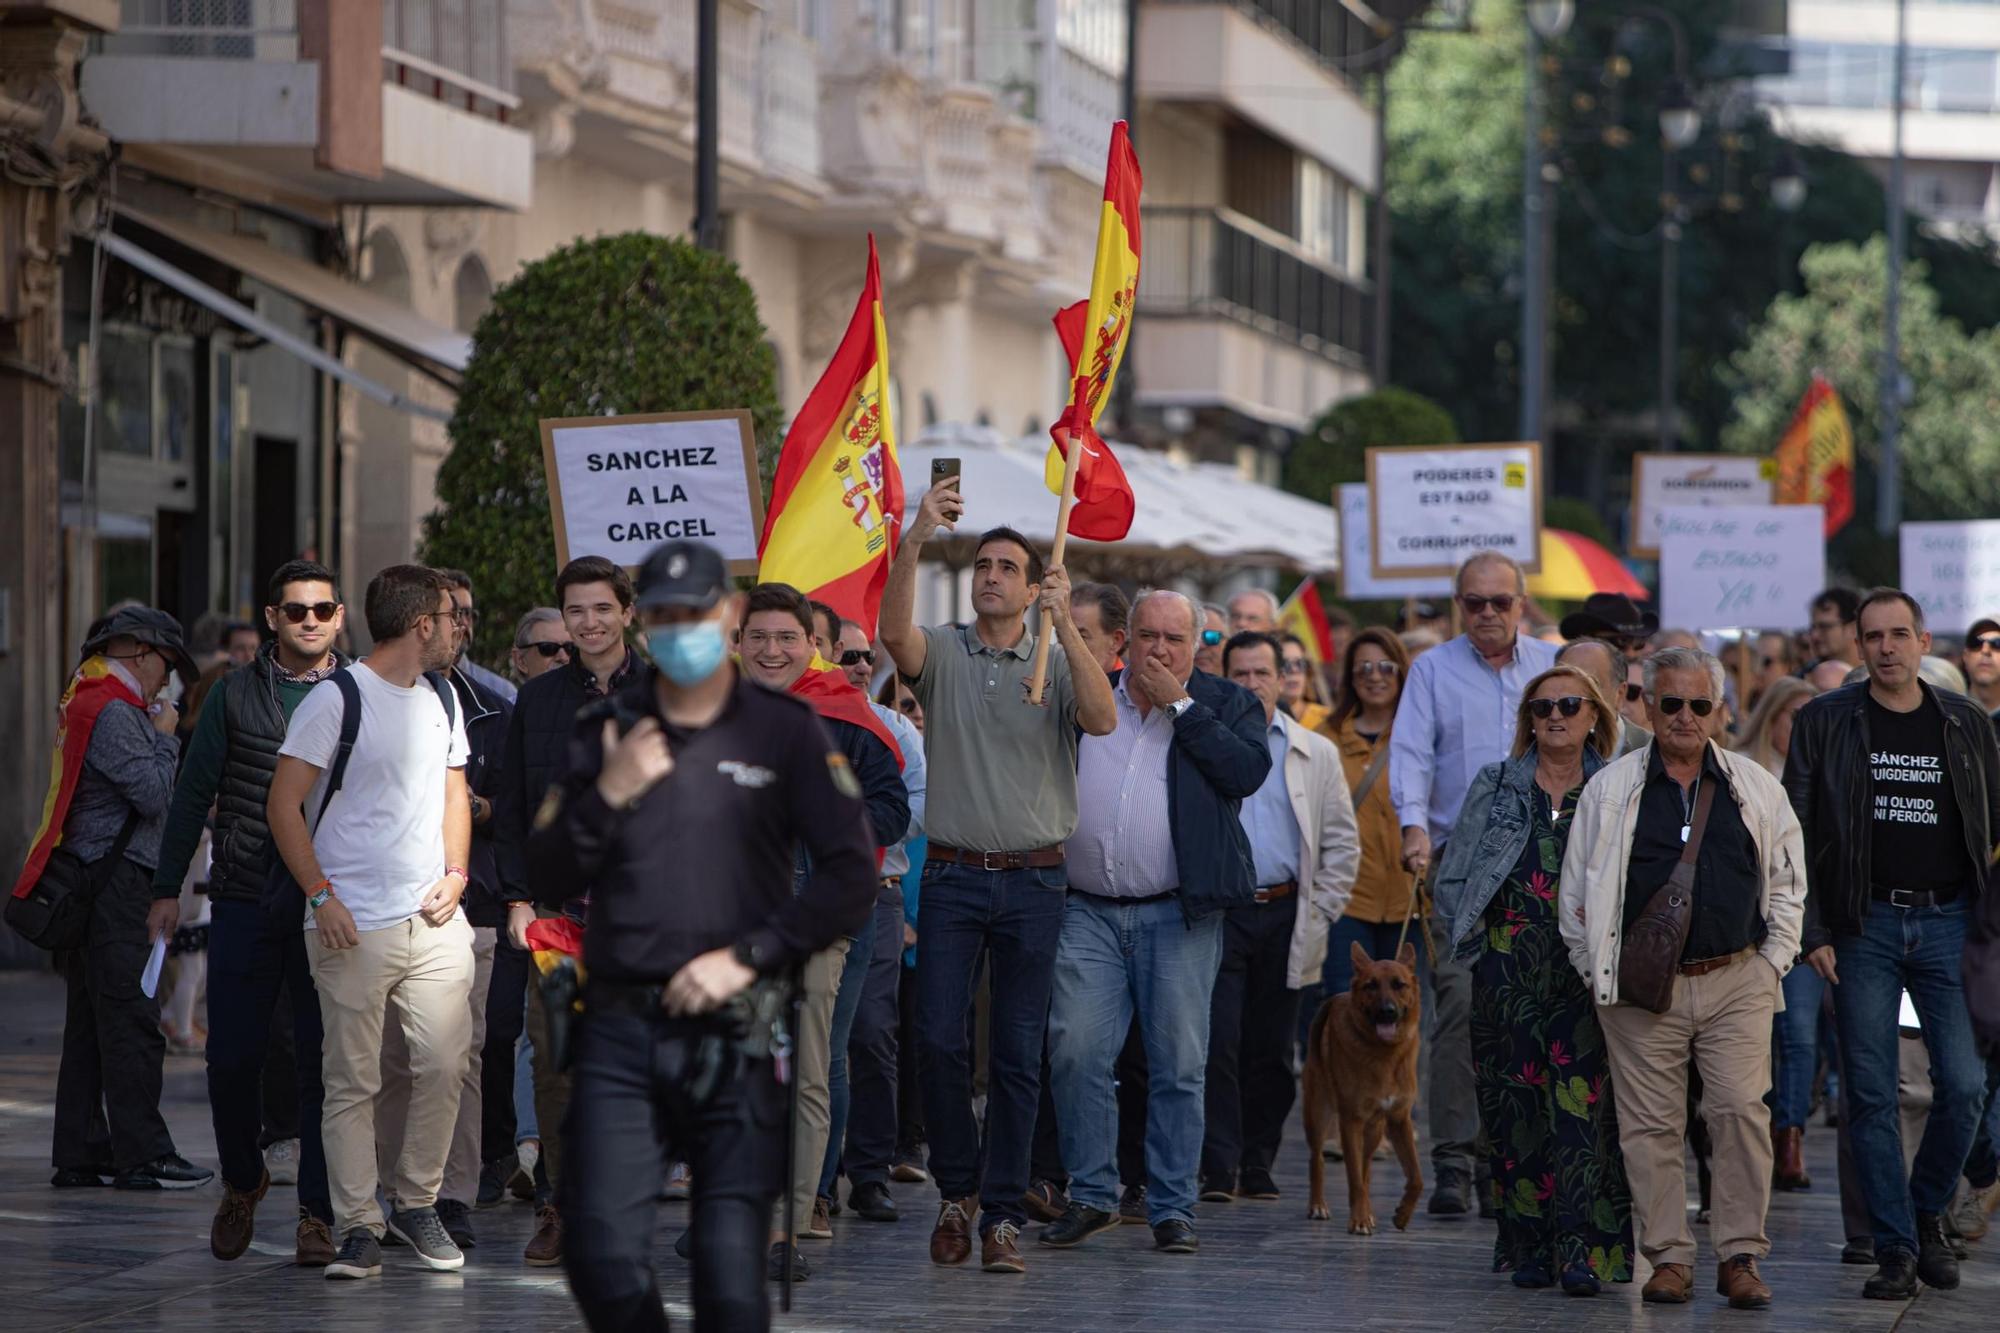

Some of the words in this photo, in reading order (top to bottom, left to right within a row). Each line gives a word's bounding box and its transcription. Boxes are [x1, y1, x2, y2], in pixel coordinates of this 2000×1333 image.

[587, 447, 717, 472] SANCHEZ
[1413, 467, 1496, 482] PODERES
[627, 487, 644, 505] A
[653, 484, 688, 504] LA
[1419, 490, 1491, 505] ESTADO
[607, 518, 716, 542] CARCEL
[1398, 534, 1517, 549] CORRUPCION
[1870, 751, 1939, 768] SÁNCHEZ
[1871, 768, 1943, 784] UIGDEMONT
[1875, 795, 1888, 807] NI
[1890, 796, 1934, 811] OLVIDO
[1874, 808, 1886, 820] NI
[1888, 809, 1938, 825] PERDÓN
